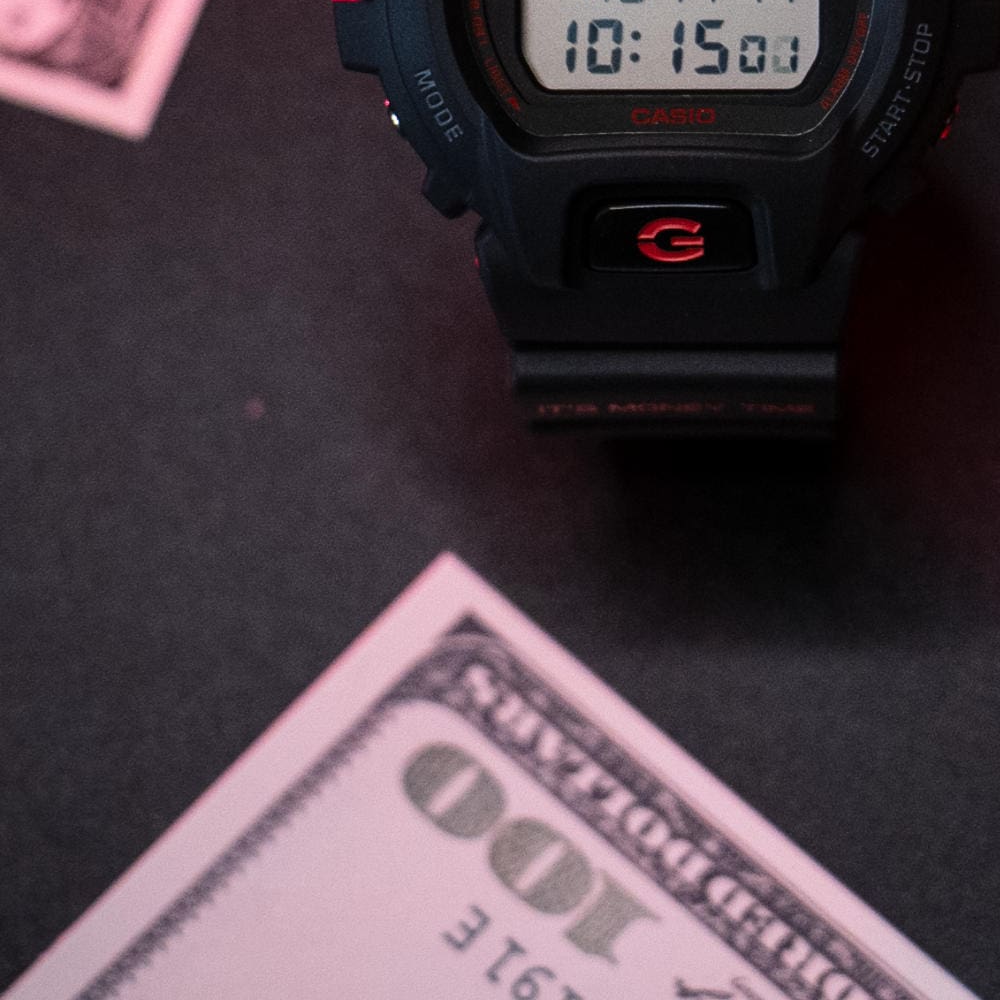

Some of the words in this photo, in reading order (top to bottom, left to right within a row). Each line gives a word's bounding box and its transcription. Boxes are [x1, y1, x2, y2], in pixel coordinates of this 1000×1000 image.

[414, 68, 464, 143] MODE
[630, 107, 717, 126] CASIO
[462, 660, 711, 888] DOLLARS
[402, 741, 661, 967] 100
